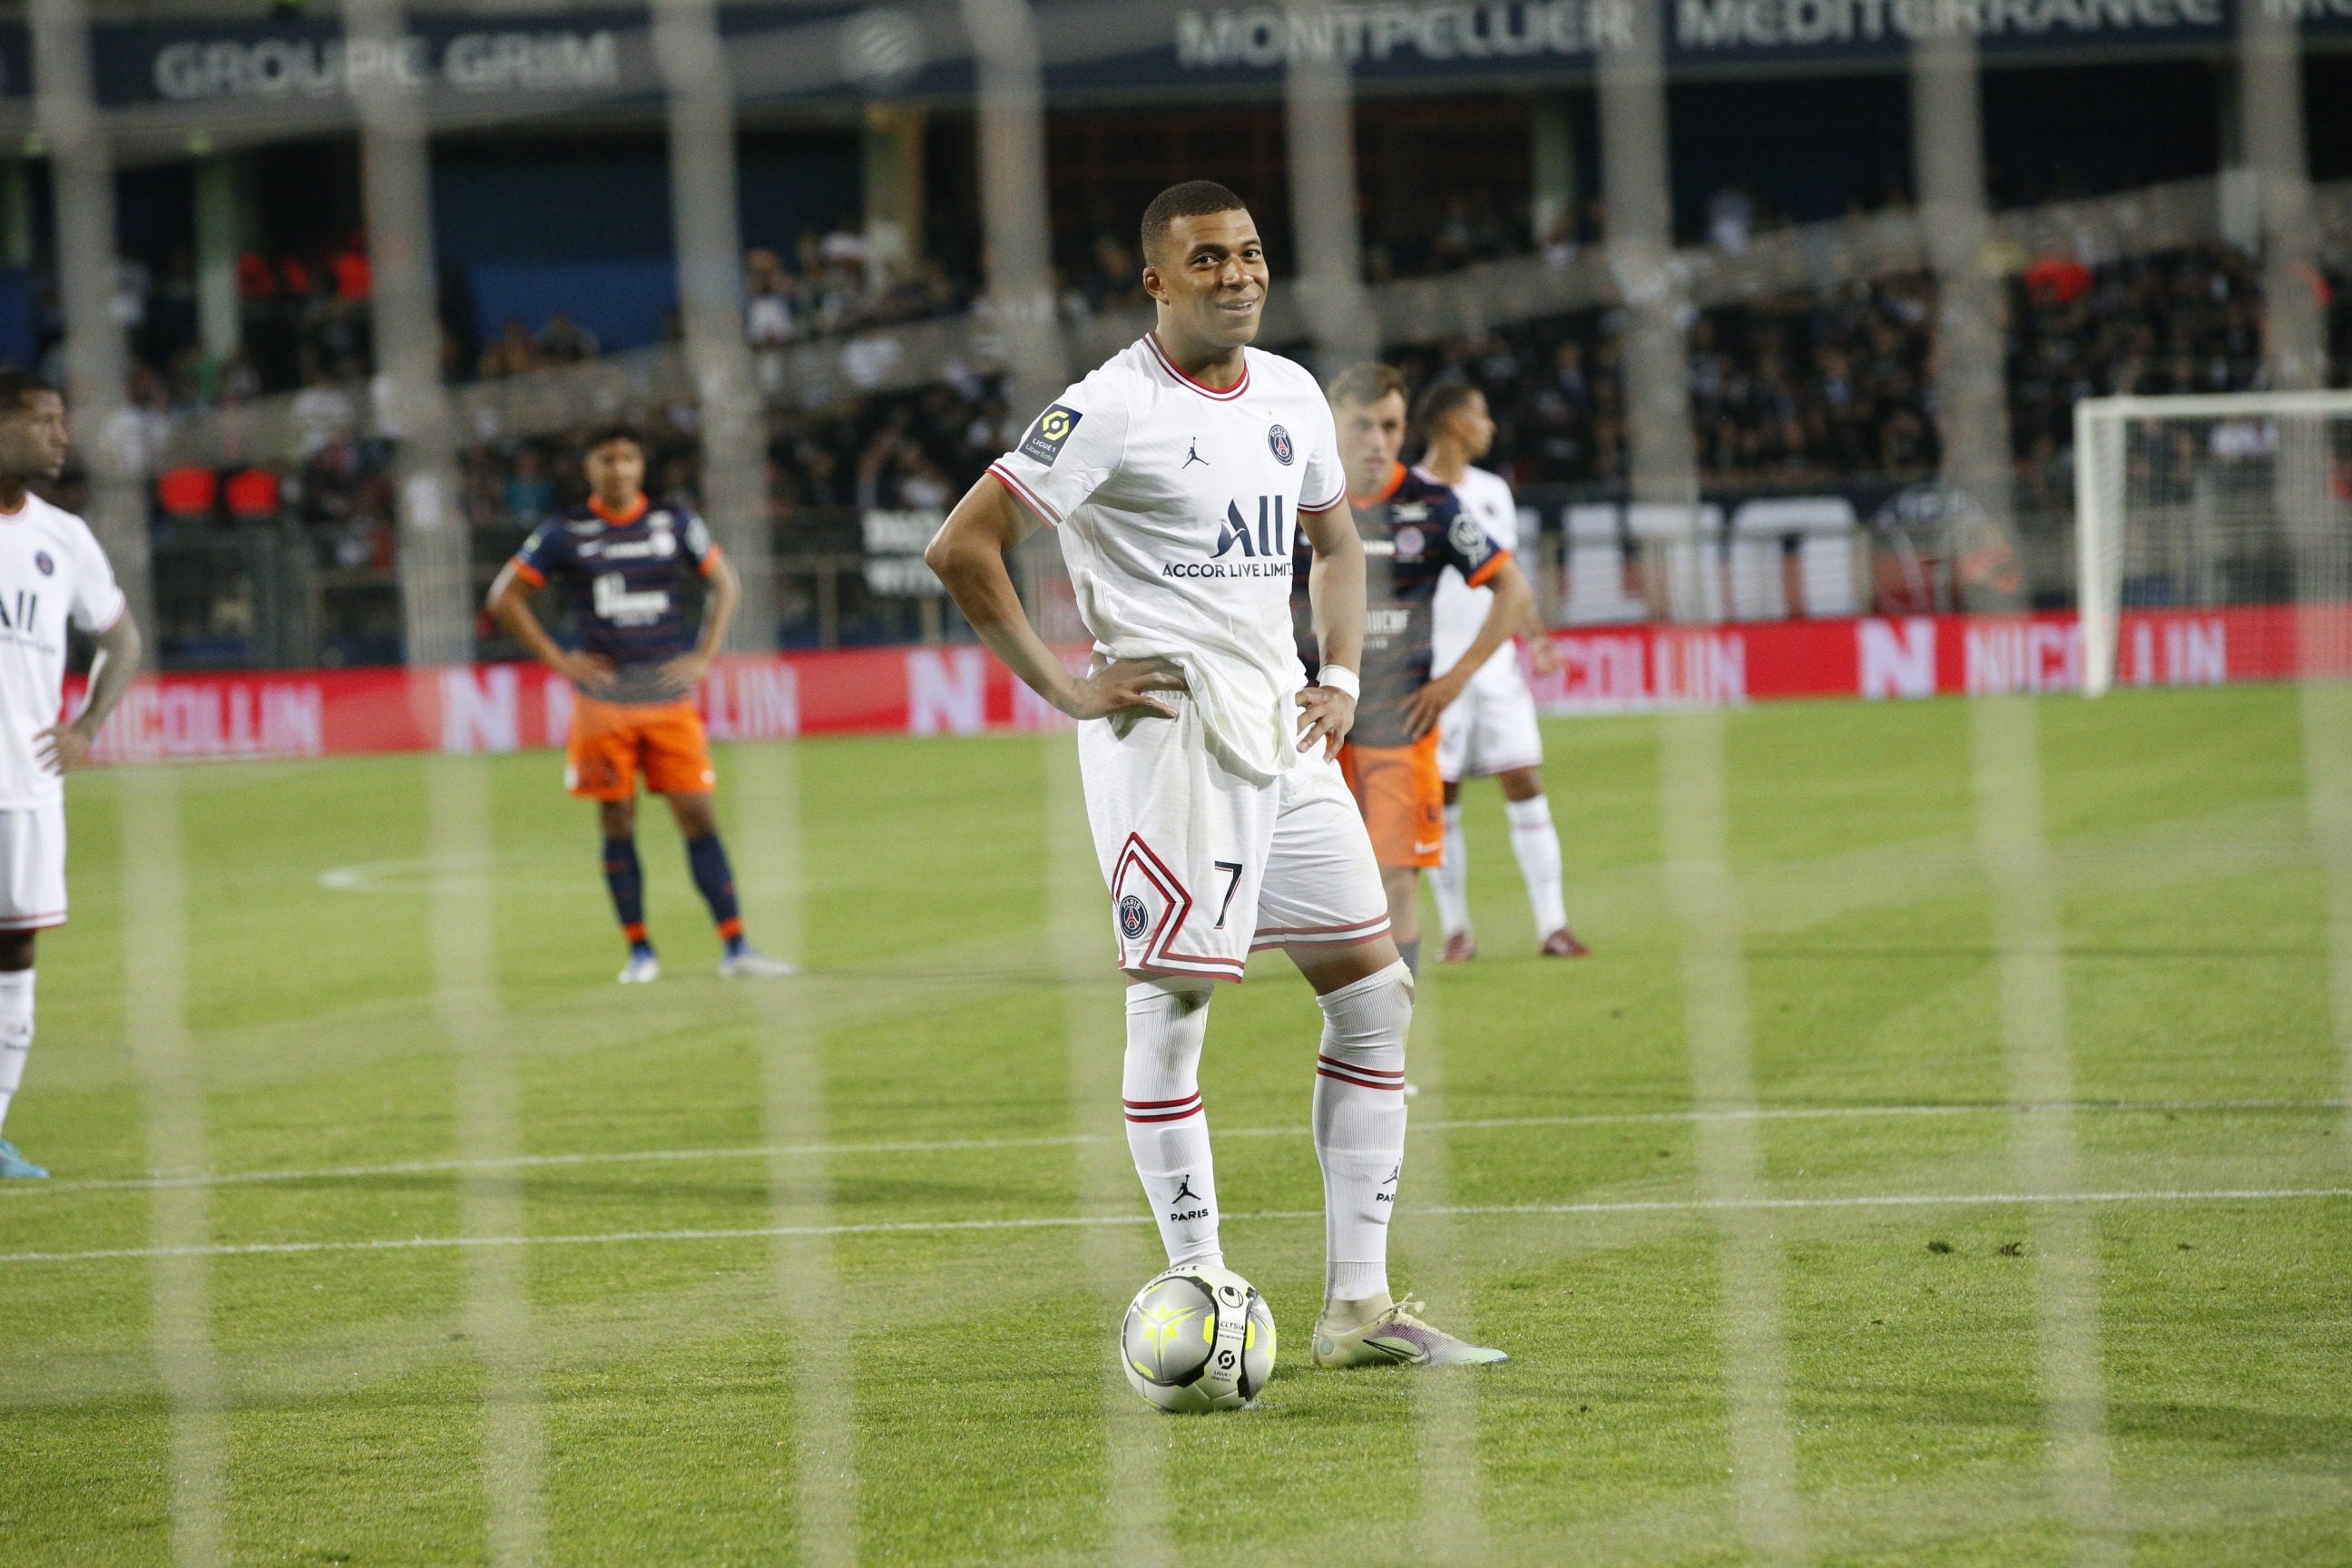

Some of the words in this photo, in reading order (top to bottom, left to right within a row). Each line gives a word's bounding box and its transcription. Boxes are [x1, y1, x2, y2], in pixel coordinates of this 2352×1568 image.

[152, 38, 433, 98] GROUPE
[1033, 438, 1052, 451] LIGUE
[1162, 564, 1225, 578] ACCOR
[1230, 563, 1259, 577] LIVE
[1264, 563, 1293, 577] LIMIT
[1859, 617, 1937, 700] N
[441, 664, 519, 752] N
[910, 646, 983, 735] N
[1214, 860, 1243, 929] 7
[1171, 1209, 1209, 1221] PARIS
[1220, 1321, 1244, 1330] ELYSIA
